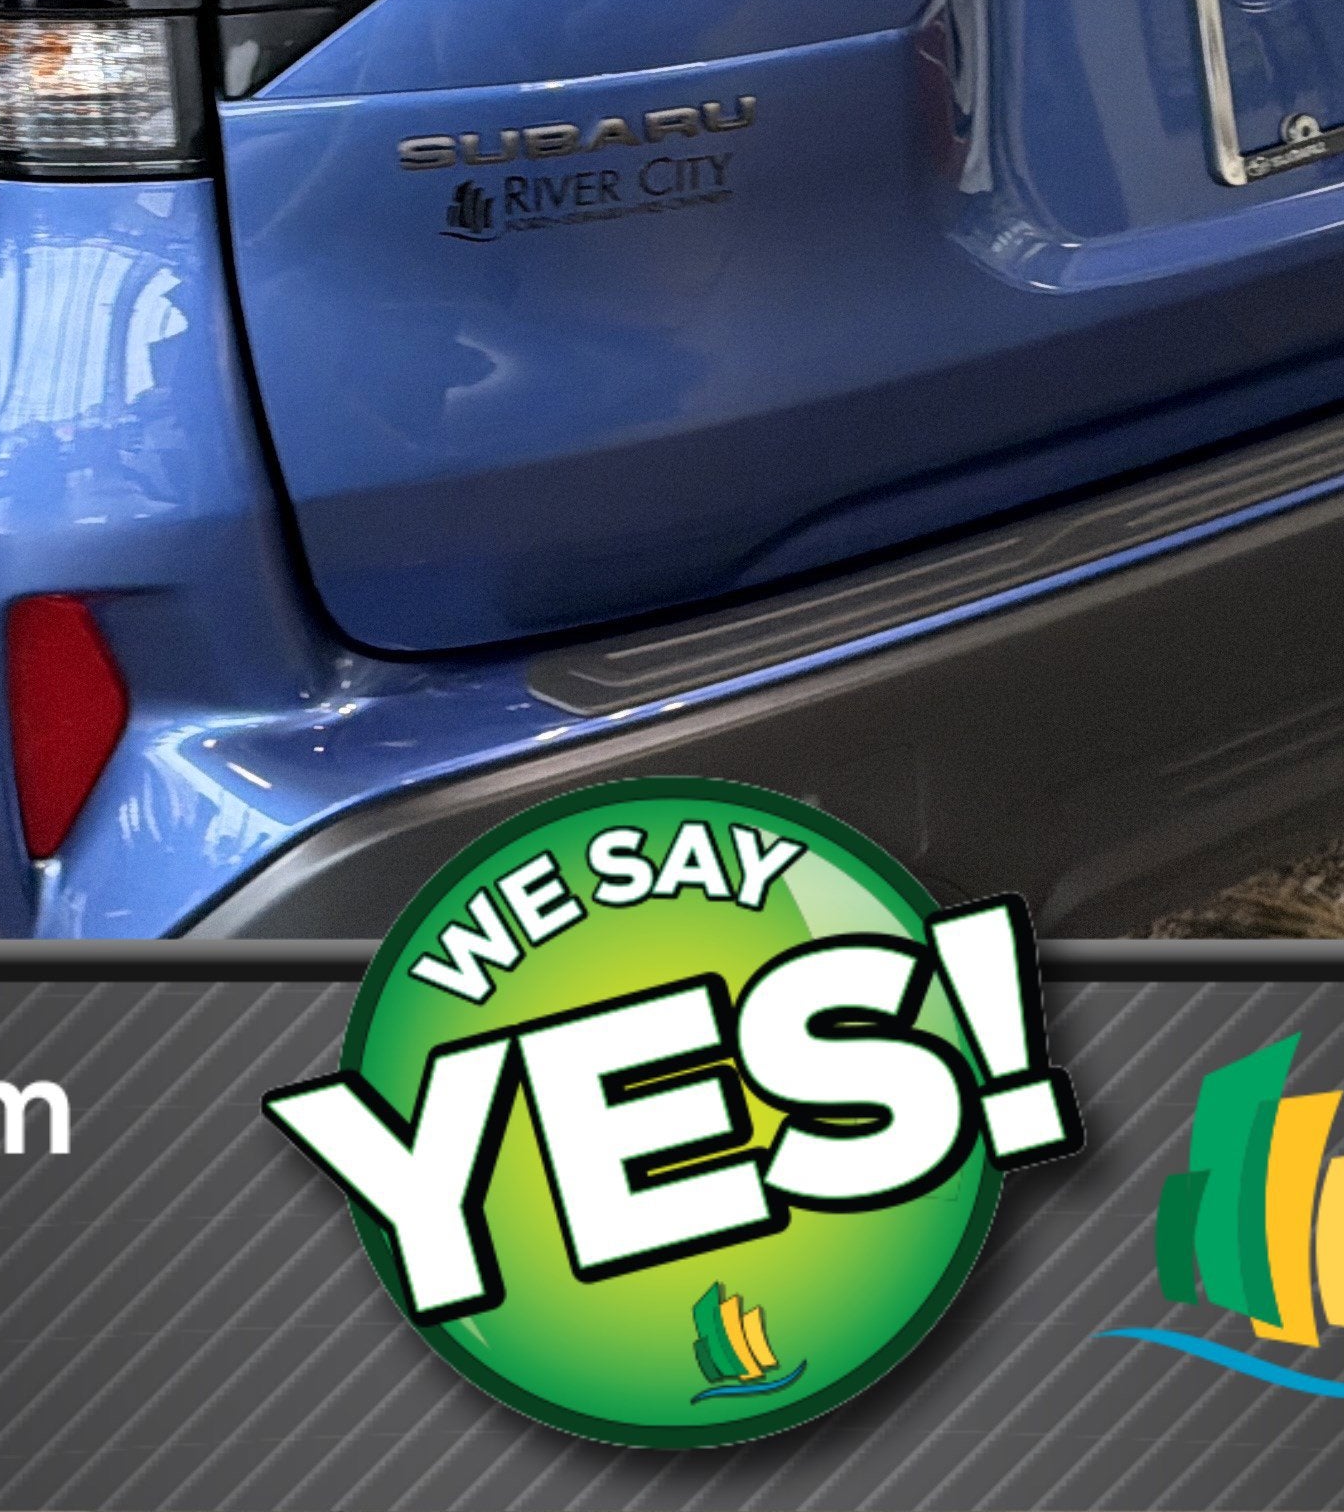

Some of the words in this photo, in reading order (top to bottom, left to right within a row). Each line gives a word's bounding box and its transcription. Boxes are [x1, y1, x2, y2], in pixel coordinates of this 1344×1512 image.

[397, 94, 756, 172] SUBARU
[504, 168, 622, 216] RIVER
[639, 150, 735, 197] CITY
